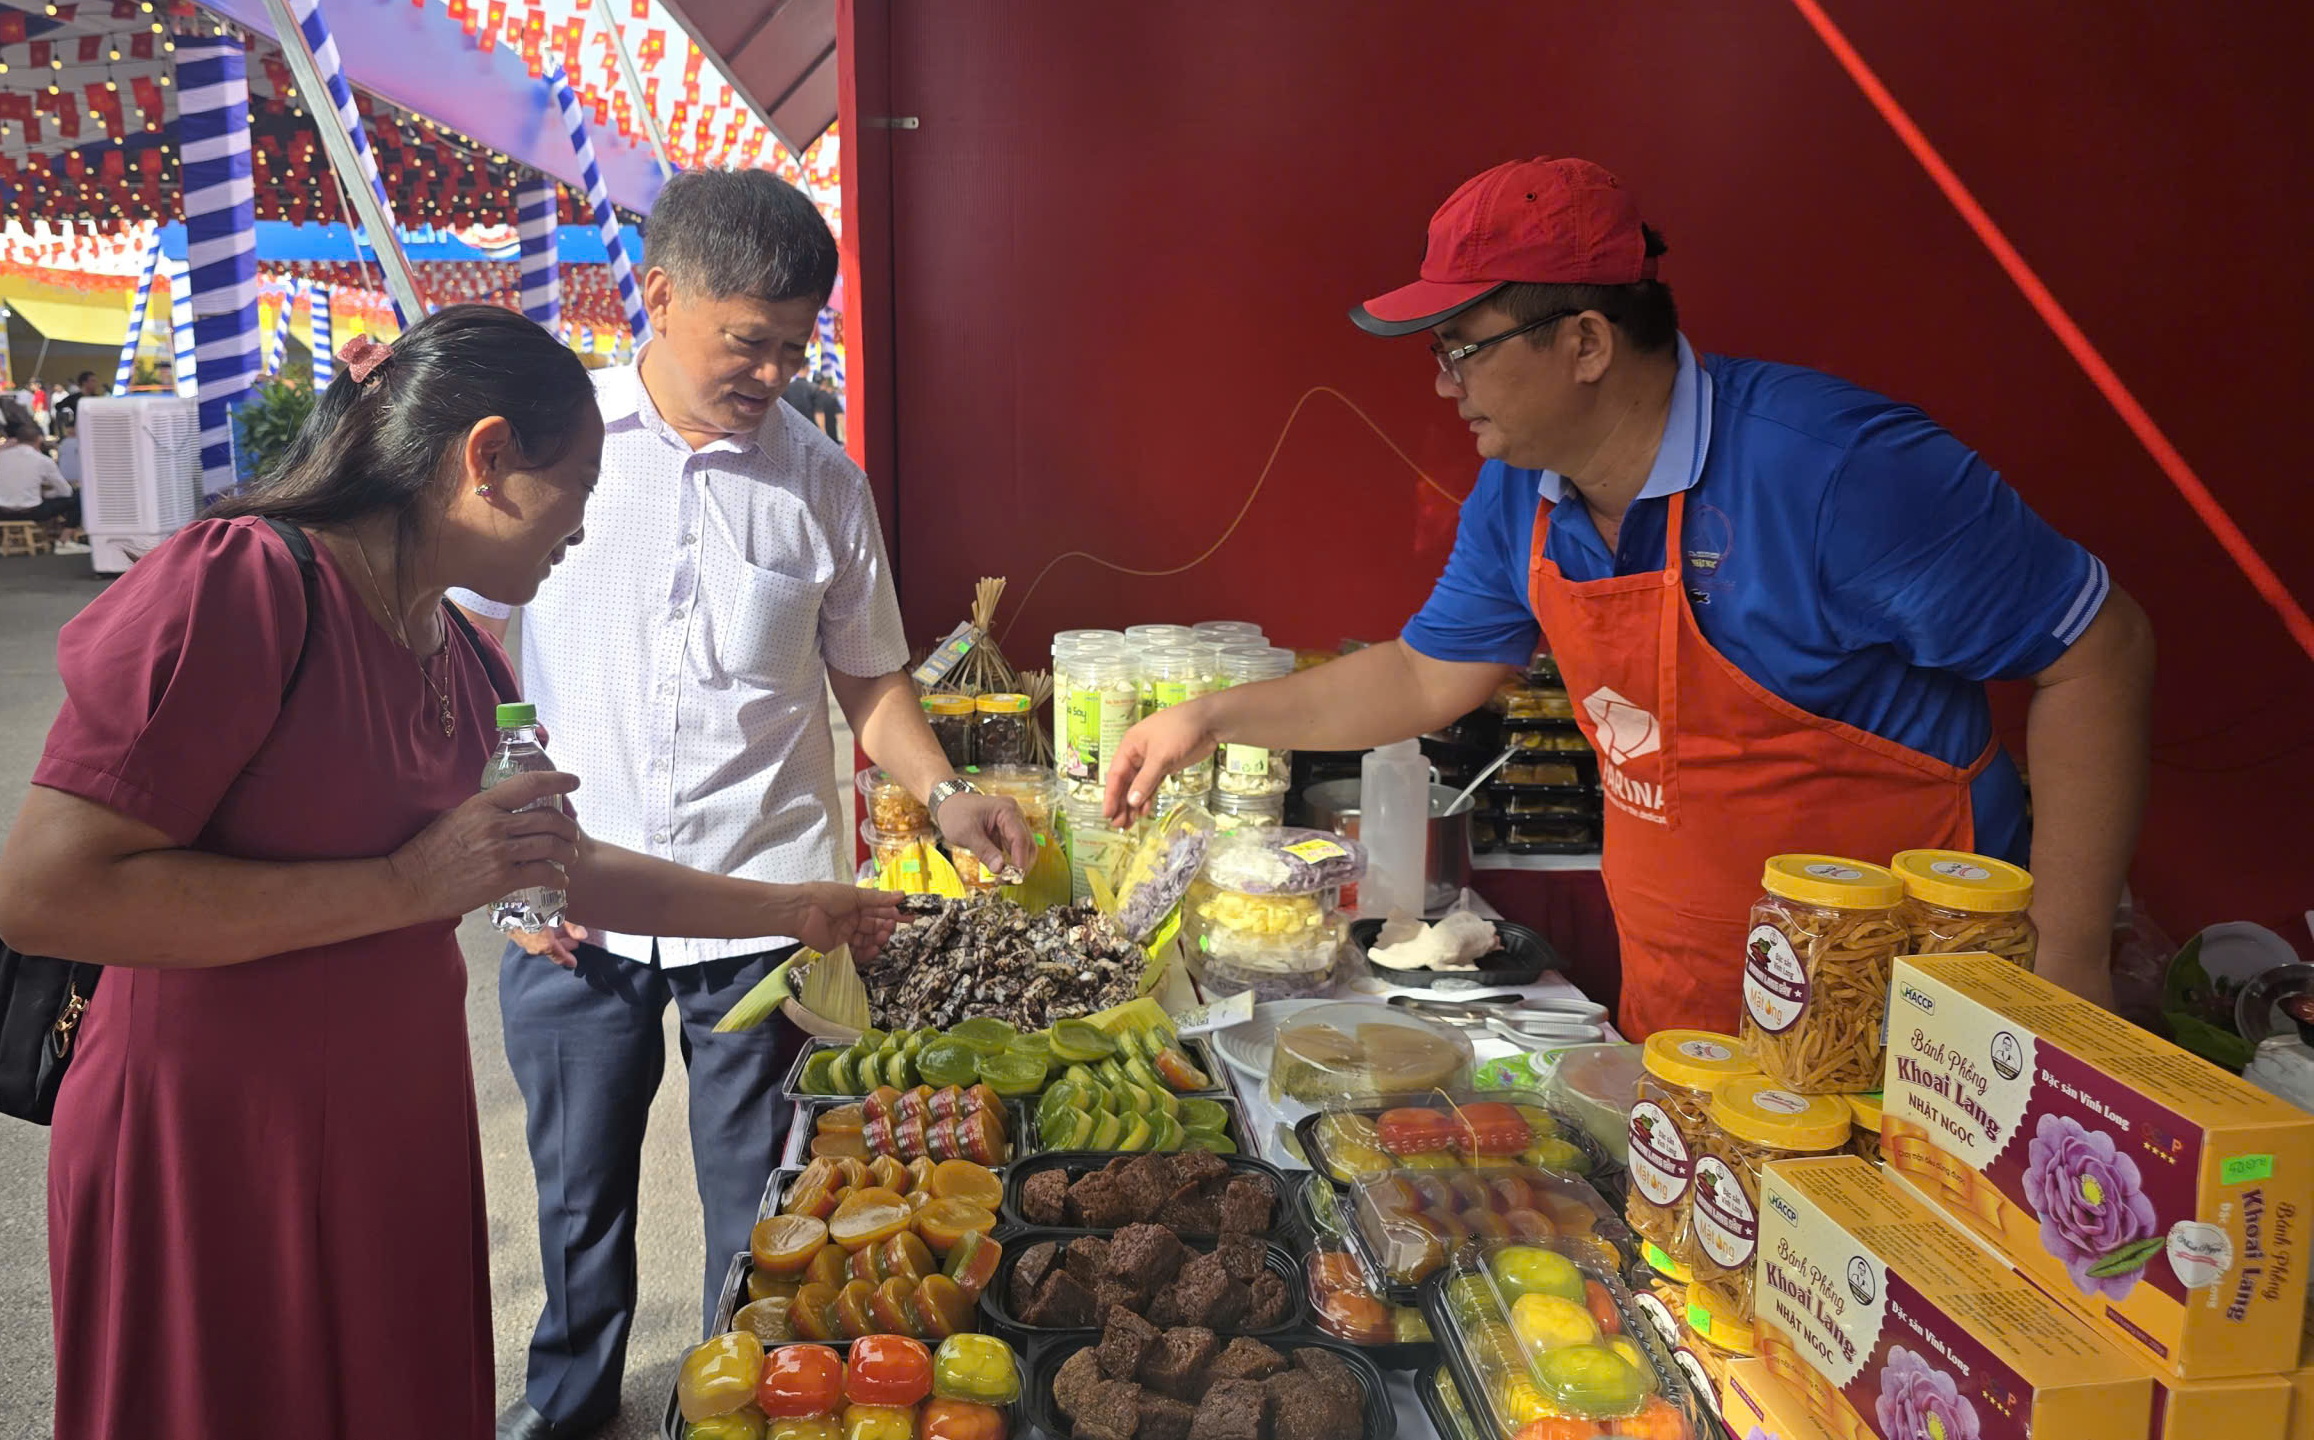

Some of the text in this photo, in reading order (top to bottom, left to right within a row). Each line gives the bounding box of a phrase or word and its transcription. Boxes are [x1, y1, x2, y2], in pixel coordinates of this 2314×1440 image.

[1904, 985, 1934, 1011] HACCP
[1911, 1028, 1989, 1096] Bánh Phồng
[1895, 1055, 2001, 1142] Khoai Lang
[1908, 1092, 1976, 1148] NHẬT NGỌC
[2041, 1069, 2060, 1088] Đặc
[2060, 1083, 2078, 1100] sản
[2080, 1090, 2102, 1114] Vĩnh
[2103, 1105, 2130, 1132] Long
[1771, 1194, 1797, 1222] HACCP
[2242, 1188, 2265, 1260] Khoai
[1777, 1237, 1807, 1277] Bánh
[1809, 1265, 1845, 1315] Phồng
[2226, 1267, 2262, 1323] Lang
[1764, 1261, 1857, 1364] Khoai Lang
[1776, 1299, 1835, 1364] NHẬT NGỌC
[1892, 1300, 1908, 1322] Đặc
[1908, 1317, 1924, 1336] sản
[1925, 1328, 1945, 1355] Vĩnh
[1947, 1347, 1970, 1377] Long
